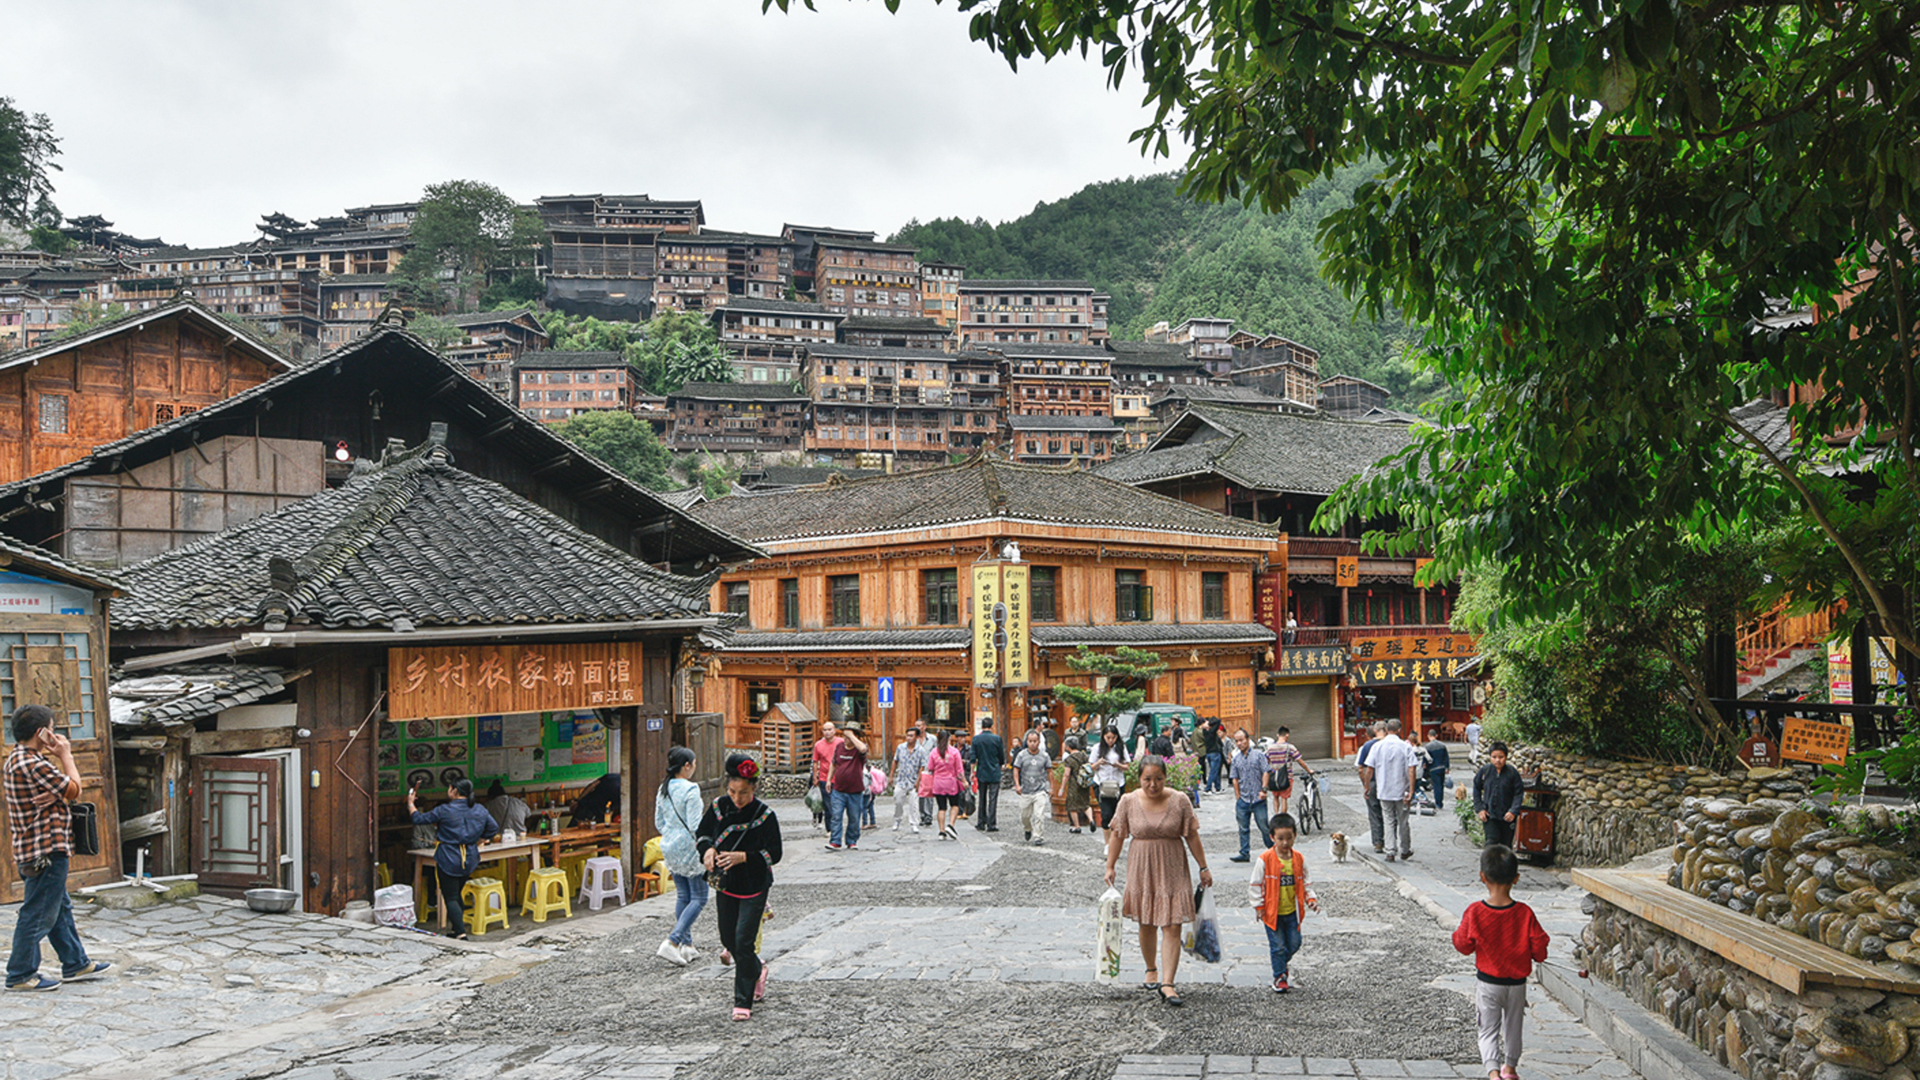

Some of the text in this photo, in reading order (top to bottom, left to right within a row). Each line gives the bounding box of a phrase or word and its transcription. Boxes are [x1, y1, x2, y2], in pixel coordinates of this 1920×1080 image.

[1261, 587, 1275, 629] 中国苗族文
[405, 651, 631, 694] 乡村农家粉面馆
[590, 689, 634, 703] 西江店
